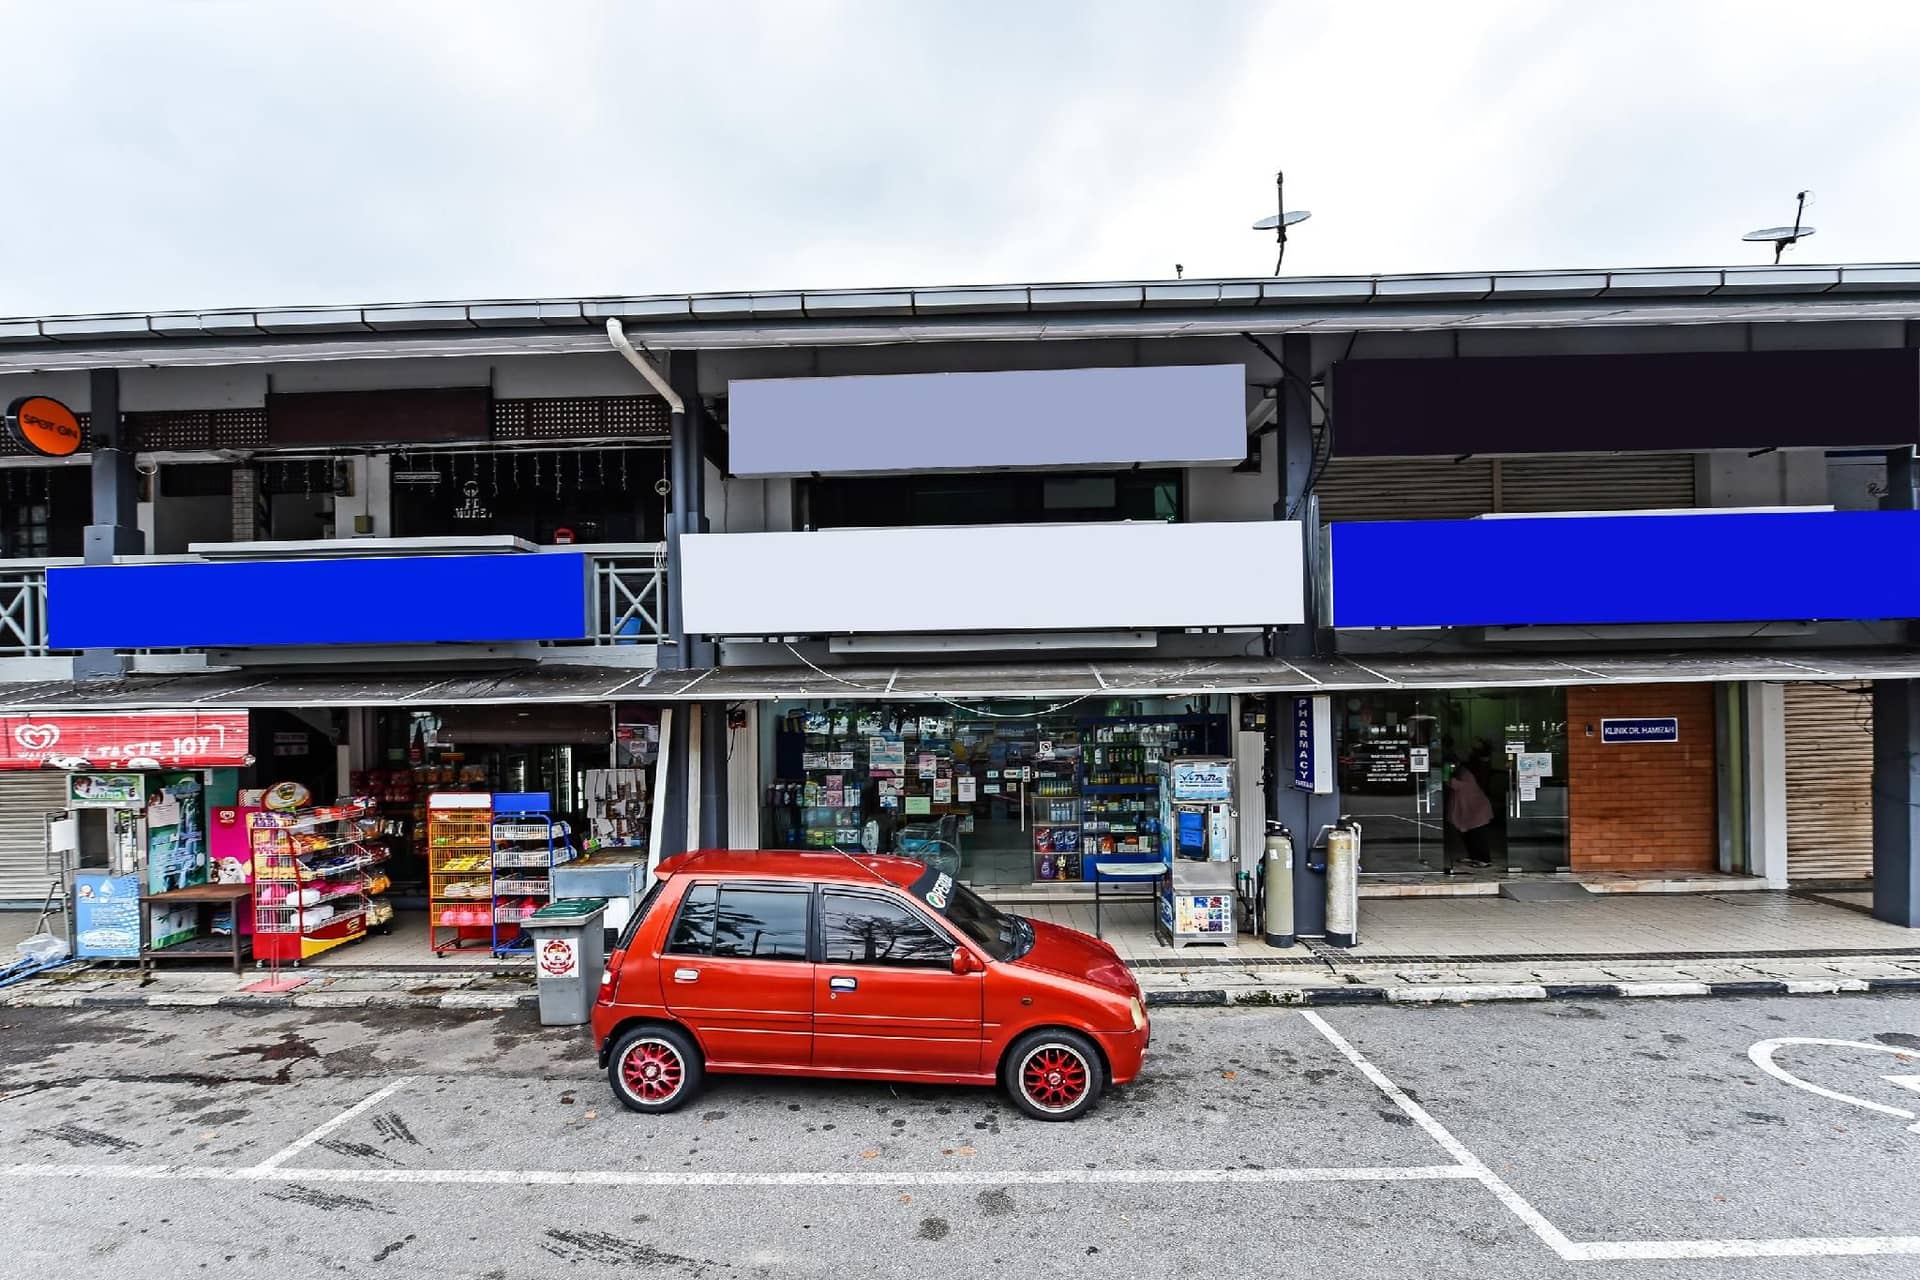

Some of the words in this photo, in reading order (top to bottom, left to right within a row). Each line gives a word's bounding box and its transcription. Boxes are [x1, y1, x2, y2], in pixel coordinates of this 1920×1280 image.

[1298, 699, 1309, 779] PHARMACY
[1605, 727, 1628, 735] KLINIK
[1641, 726, 1675, 734] HAMIZAH
[96, 741, 162, 756] TASTE
[167, 736, 211, 756] JOY
